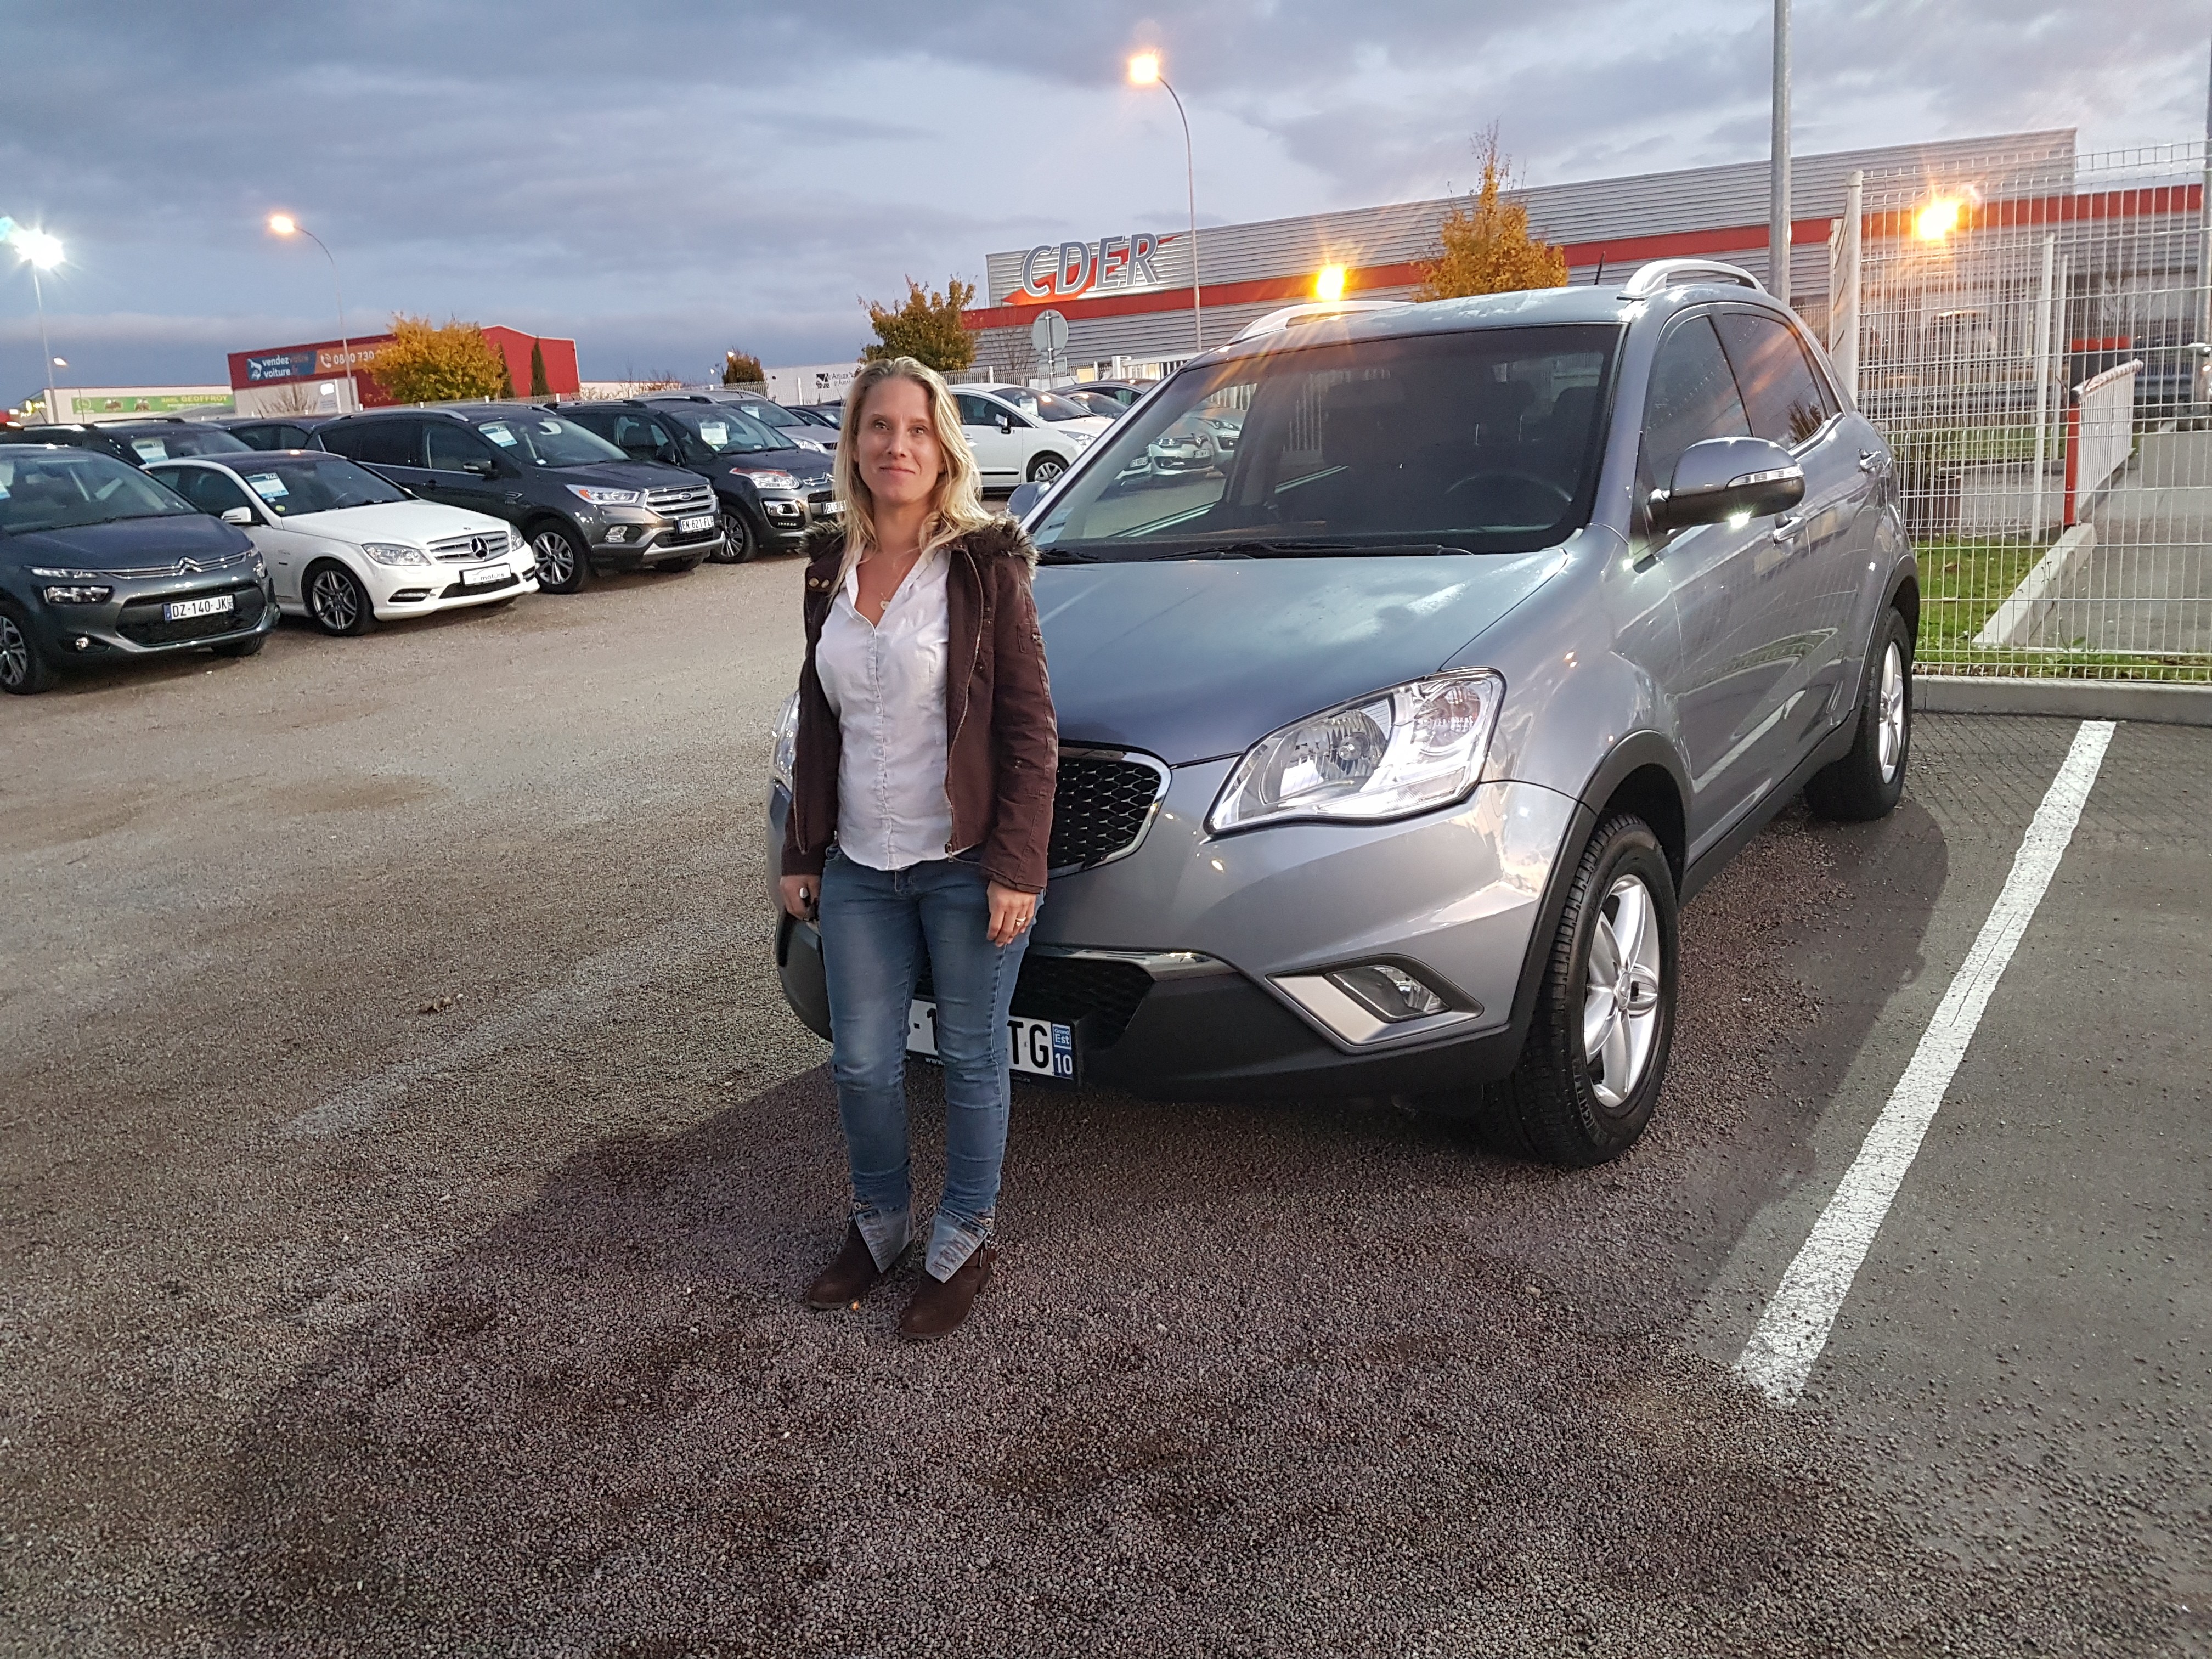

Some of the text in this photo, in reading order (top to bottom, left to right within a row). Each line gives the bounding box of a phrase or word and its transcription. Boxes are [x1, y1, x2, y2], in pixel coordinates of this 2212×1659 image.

[1022, 233, 1159, 297] CDER
[682, 517, 711, 530] EN-621-FL
[172, 597, 227, 617] DZ-140-JK
[1055, 1034, 1070, 1045] Est
[1055, 1053, 1073, 1075] 10
